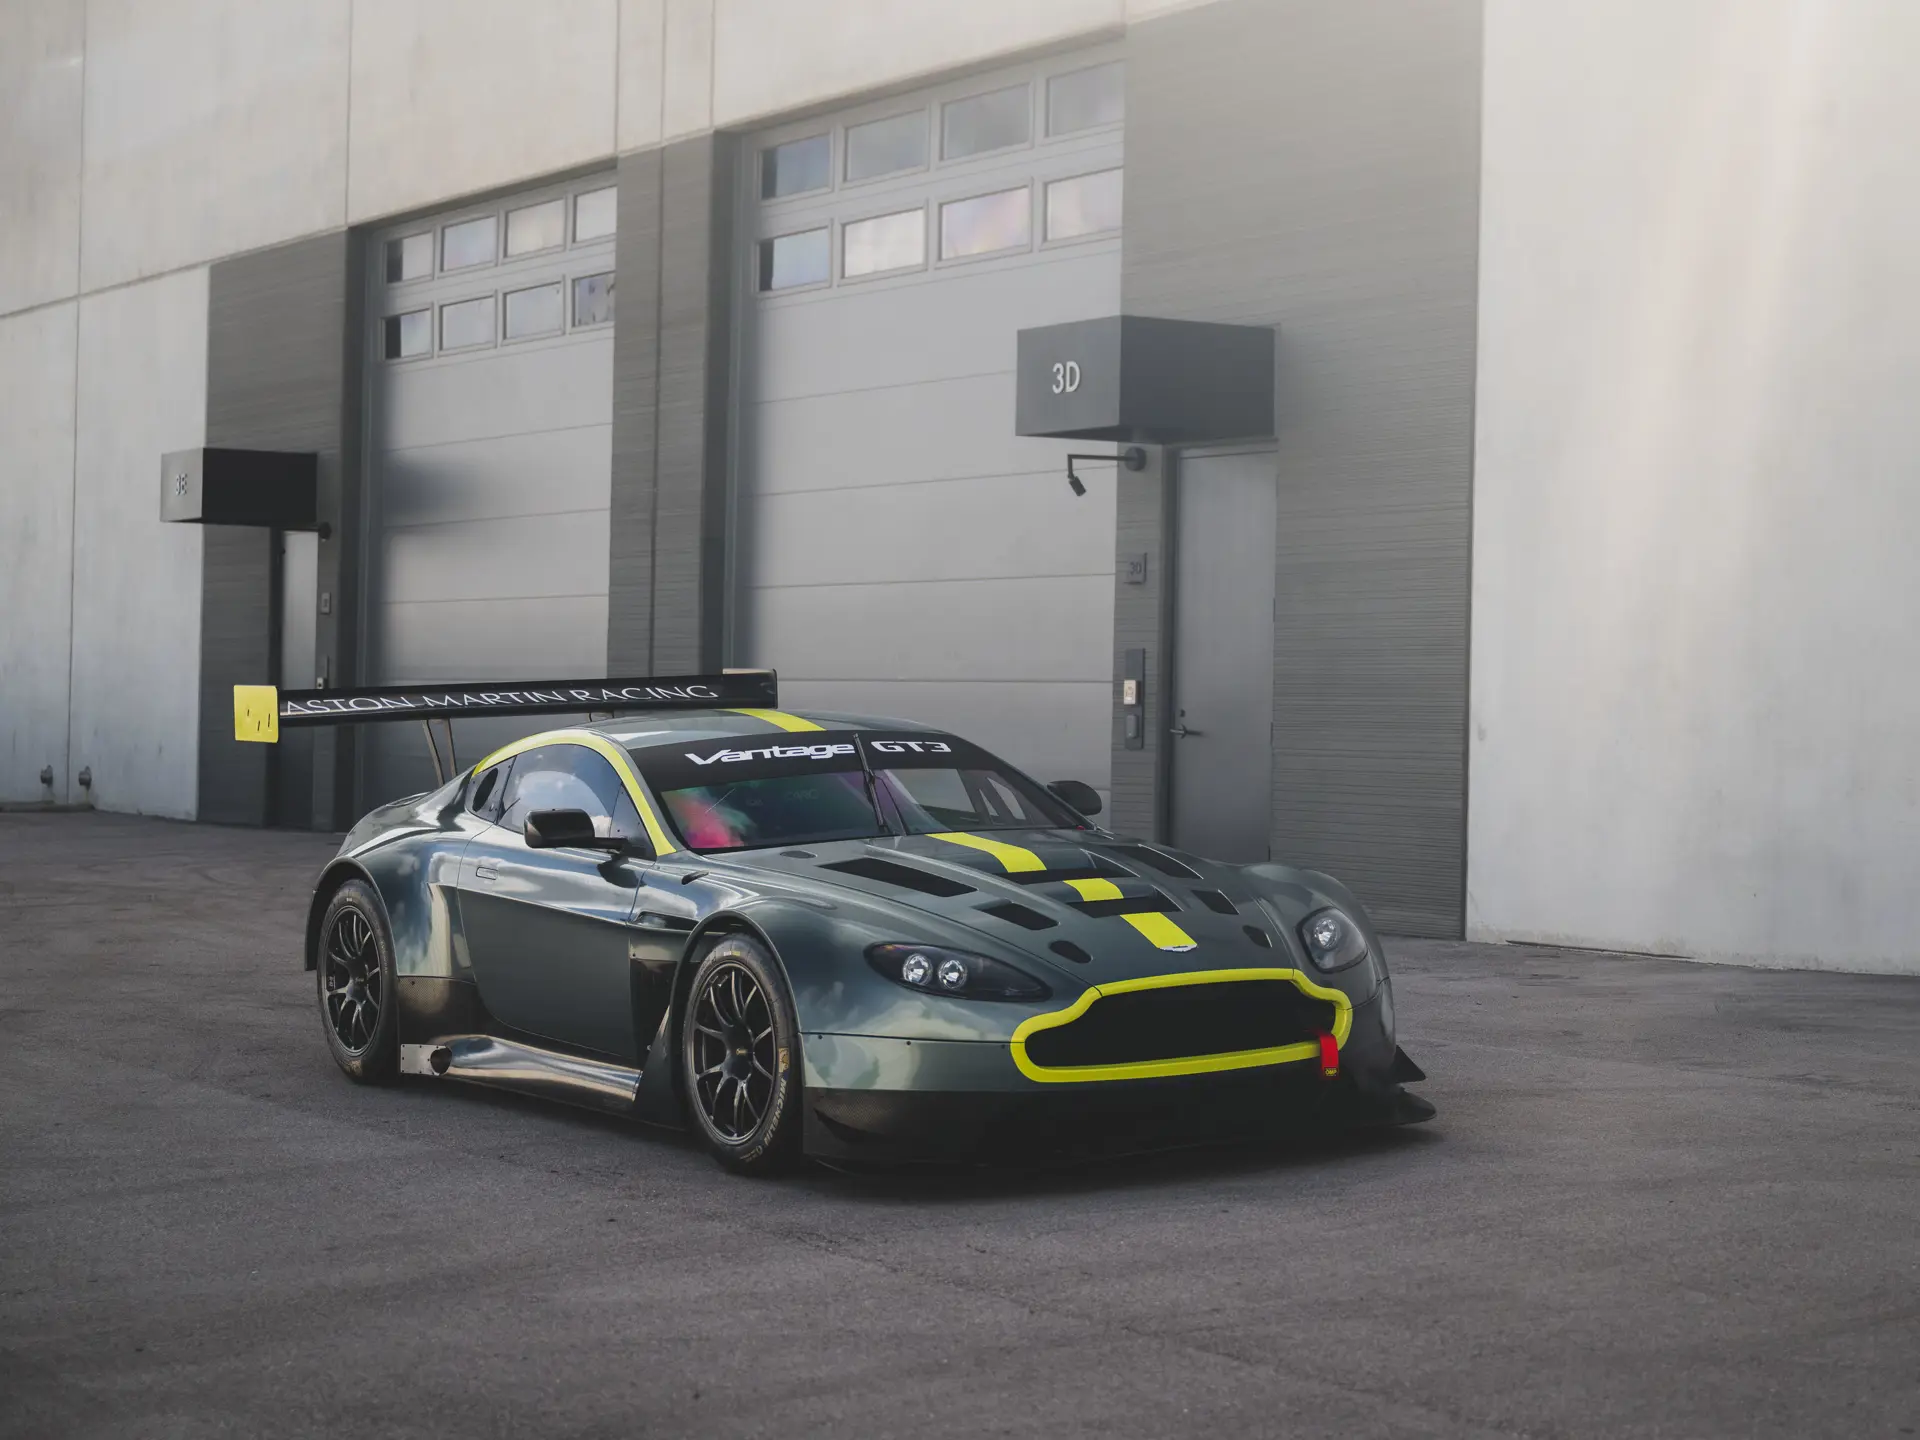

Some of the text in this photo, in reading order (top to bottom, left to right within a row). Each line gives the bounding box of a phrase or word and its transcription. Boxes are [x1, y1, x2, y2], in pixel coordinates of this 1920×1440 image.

[1052, 361, 1081, 394] 3D
[287, 685, 719, 715] ASTON MARTIN RACING
[685, 741, 952, 765] Vantage GT3
[764, 1078, 787, 1146] MICHELIN
